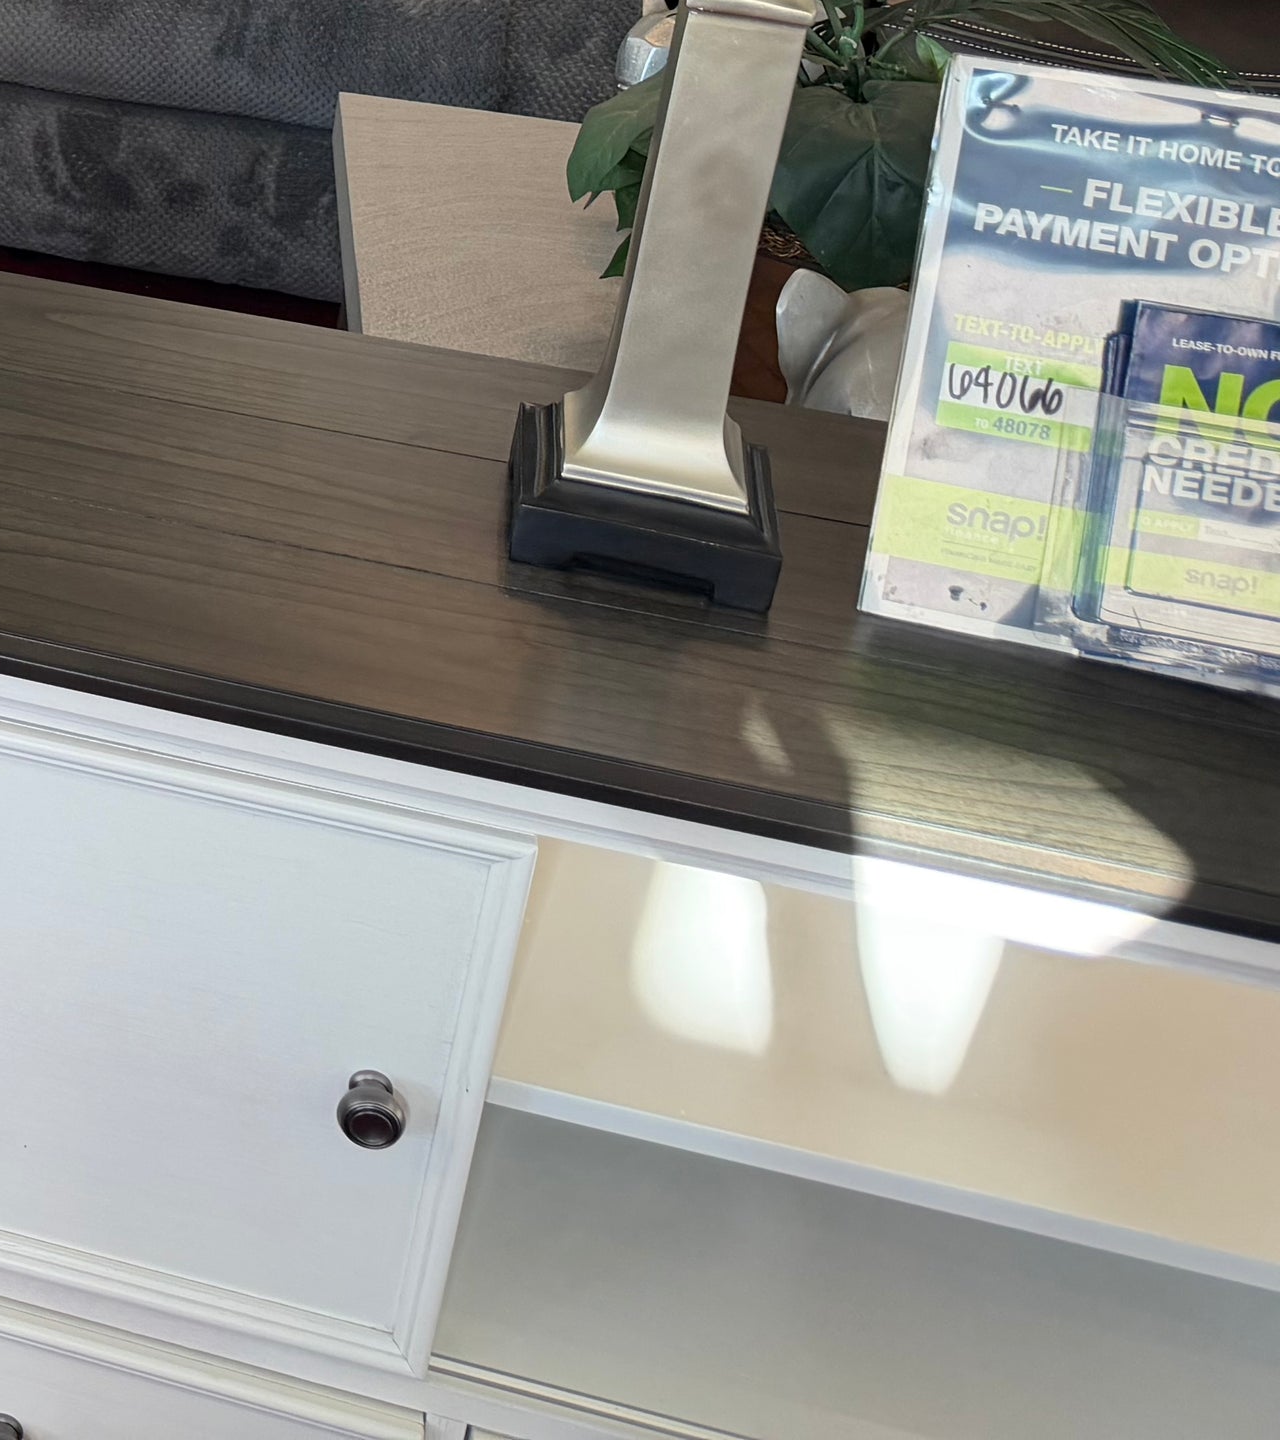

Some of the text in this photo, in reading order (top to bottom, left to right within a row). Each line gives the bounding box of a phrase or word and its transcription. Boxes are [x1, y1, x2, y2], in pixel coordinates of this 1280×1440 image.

[1051, 123, 1121, 152] TAKE
[1126, 135, 1153, 156] IT
[1158, 140, 1243, 171] HOME
[973, 202, 1280, 282] PAYMENT OPT
[1004, 355, 1043, 375] TEXT
[1172, 337, 1268, 360] LEASE-TO-OWN
[948, 363, 1064, 415] 64066
[992, 417, 1051, 440] 48078
[946, 502, 1048, 545] snap!
[1185, 567, 1258, 596] snap!
